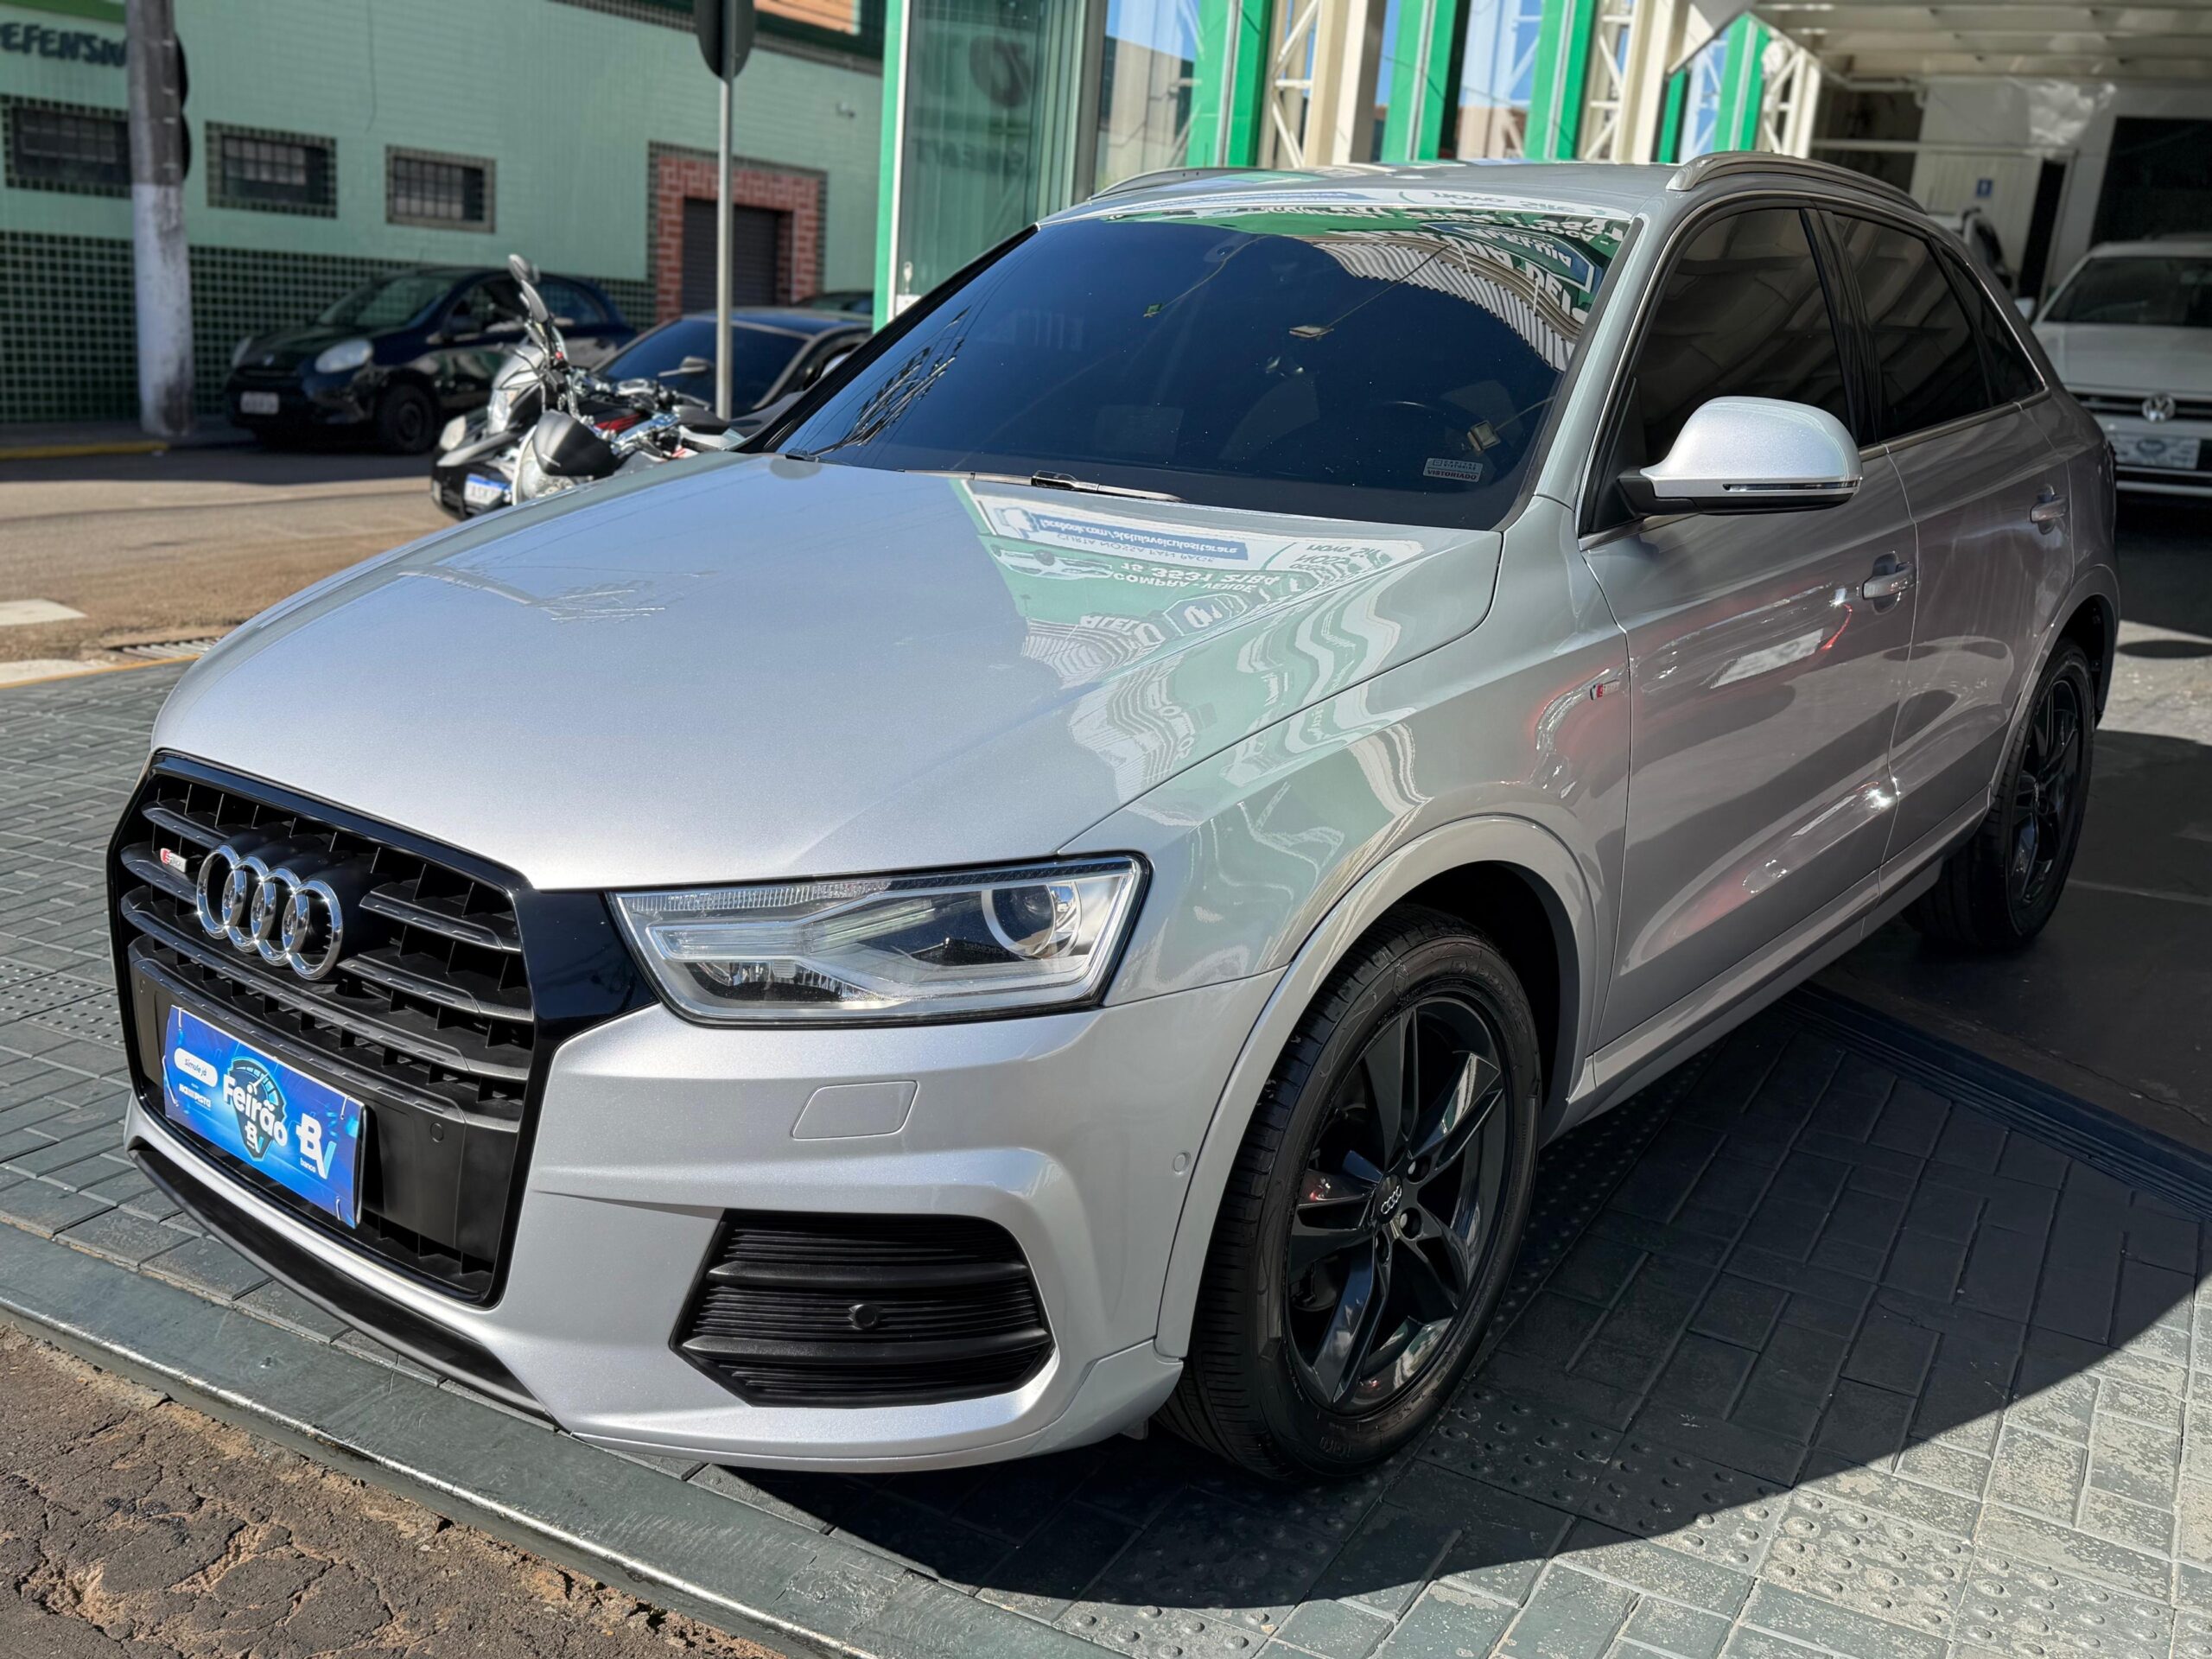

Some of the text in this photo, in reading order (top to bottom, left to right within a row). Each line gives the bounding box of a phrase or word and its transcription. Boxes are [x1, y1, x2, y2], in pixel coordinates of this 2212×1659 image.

[0, 22, 127, 67] EFENSIV
[1427, 469, 1477, 480] VISTORIADO
[223, 1073, 288, 1147] Feirão
[299, 1156, 316, 1173] banco
